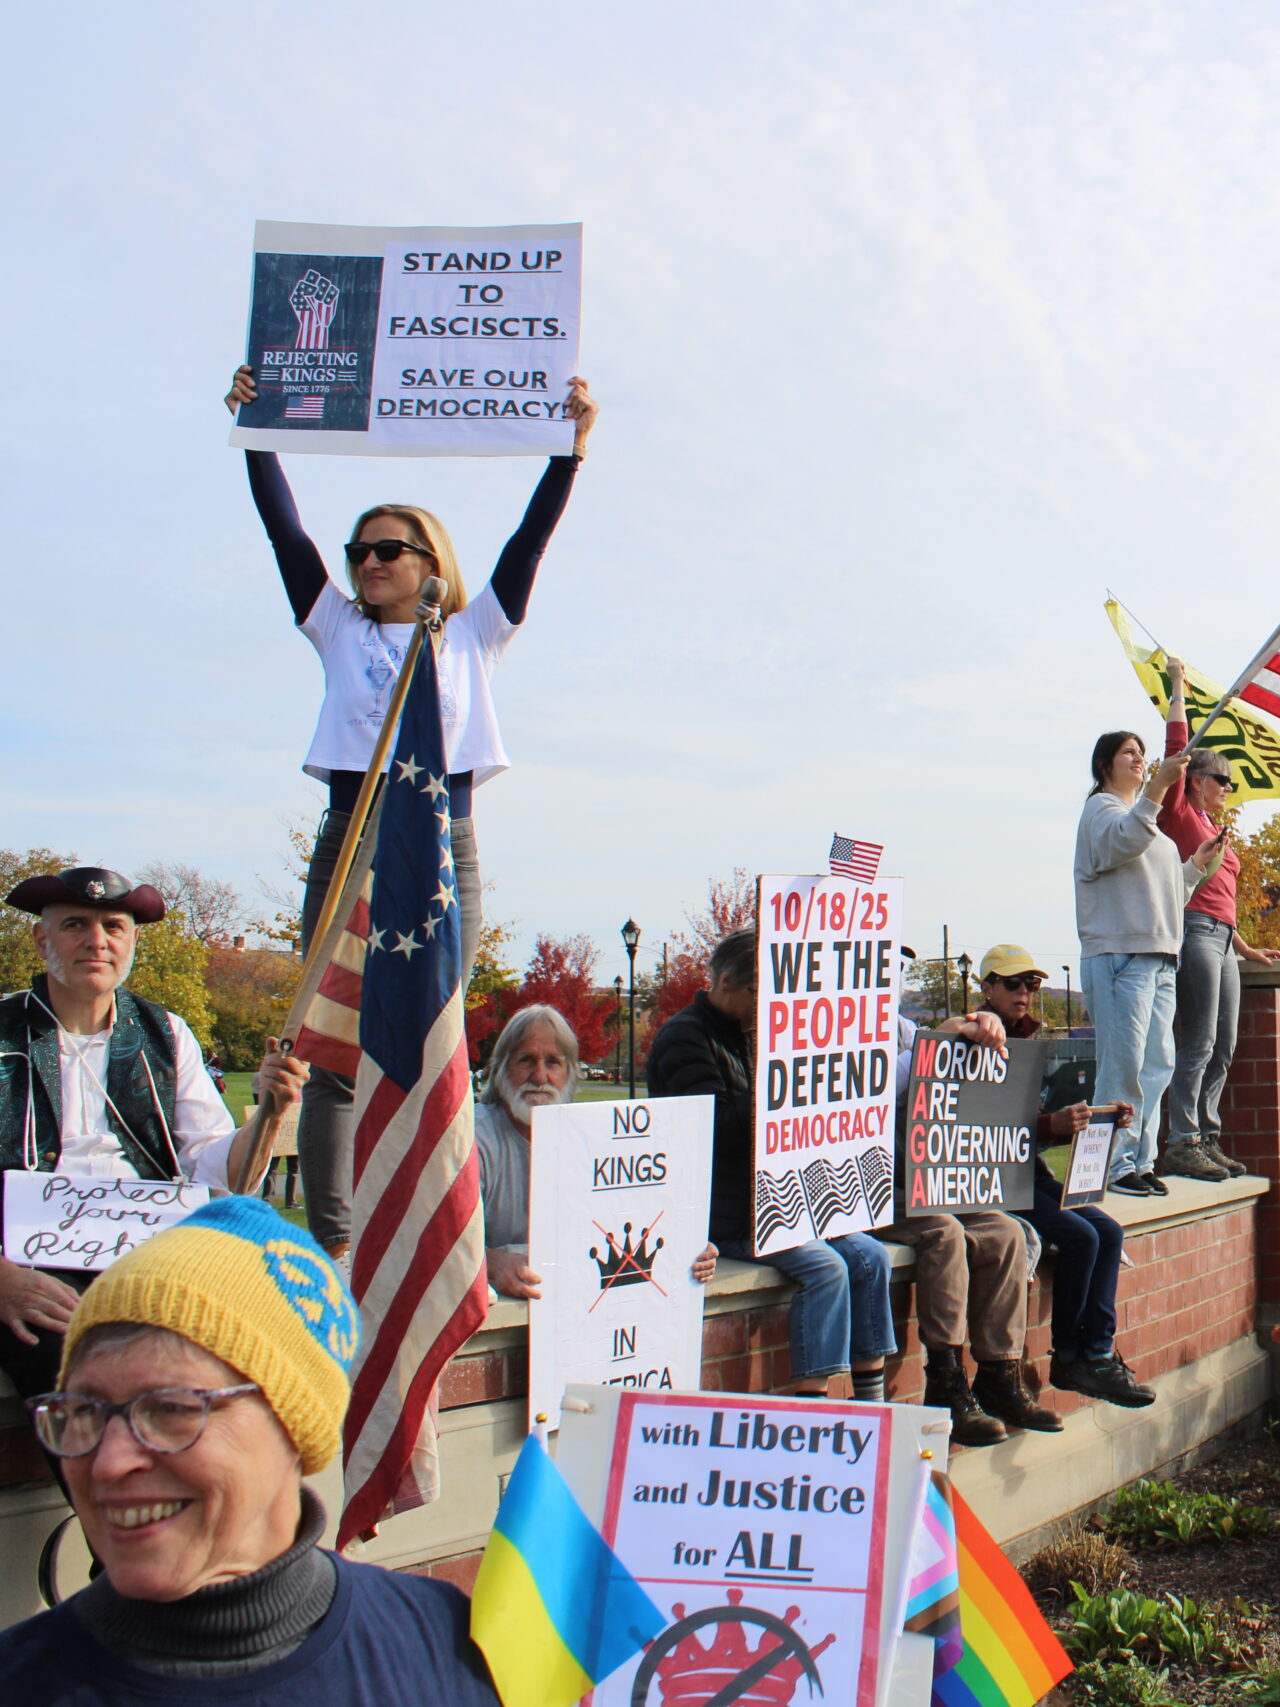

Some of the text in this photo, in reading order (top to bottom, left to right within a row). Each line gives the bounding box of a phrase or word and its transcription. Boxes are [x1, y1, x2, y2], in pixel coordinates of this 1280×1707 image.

[402, 250, 562, 272] STAND UP
[458, 284, 504, 305] TO
[389, 316, 567, 337] FASCISCTS.
[262, 351, 358, 366] REJECTING
[280, 368, 336, 382] KINGS
[282, 385, 330, 393] SINCE 1776
[400, 369, 547, 389] SAVE OUR
[770, 886, 888, 939] 10/18/25
[770, 940, 892, 994] WE THE
[769, 994, 891, 1052] PEOPLE
[915, 1038, 1008, 1083] MORONS
[767, 1048, 889, 1111] DEFEND
[613, 1104, 650, 1134] NO
[911, 1081, 960, 1121] ARE
[766, 1104, 889, 1155] DEMOCRACY
[910, 1123, 1030, 1163] GOVERNING
[593, 1152, 667, 1186] KINGS
[911, 1166, 1003, 1208] AMERICA
[43, 1175, 199, 1208] Protect
[58, 1201, 162, 1232] Your
[24, 1230, 154, 1267] Righ
[612, 1326, 636, 1357] IN
[641, 1411, 873, 1463] with Liberty
[633, 1470, 866, 1514] and Justice
[673, 1530, 814, 1572] for ALL
